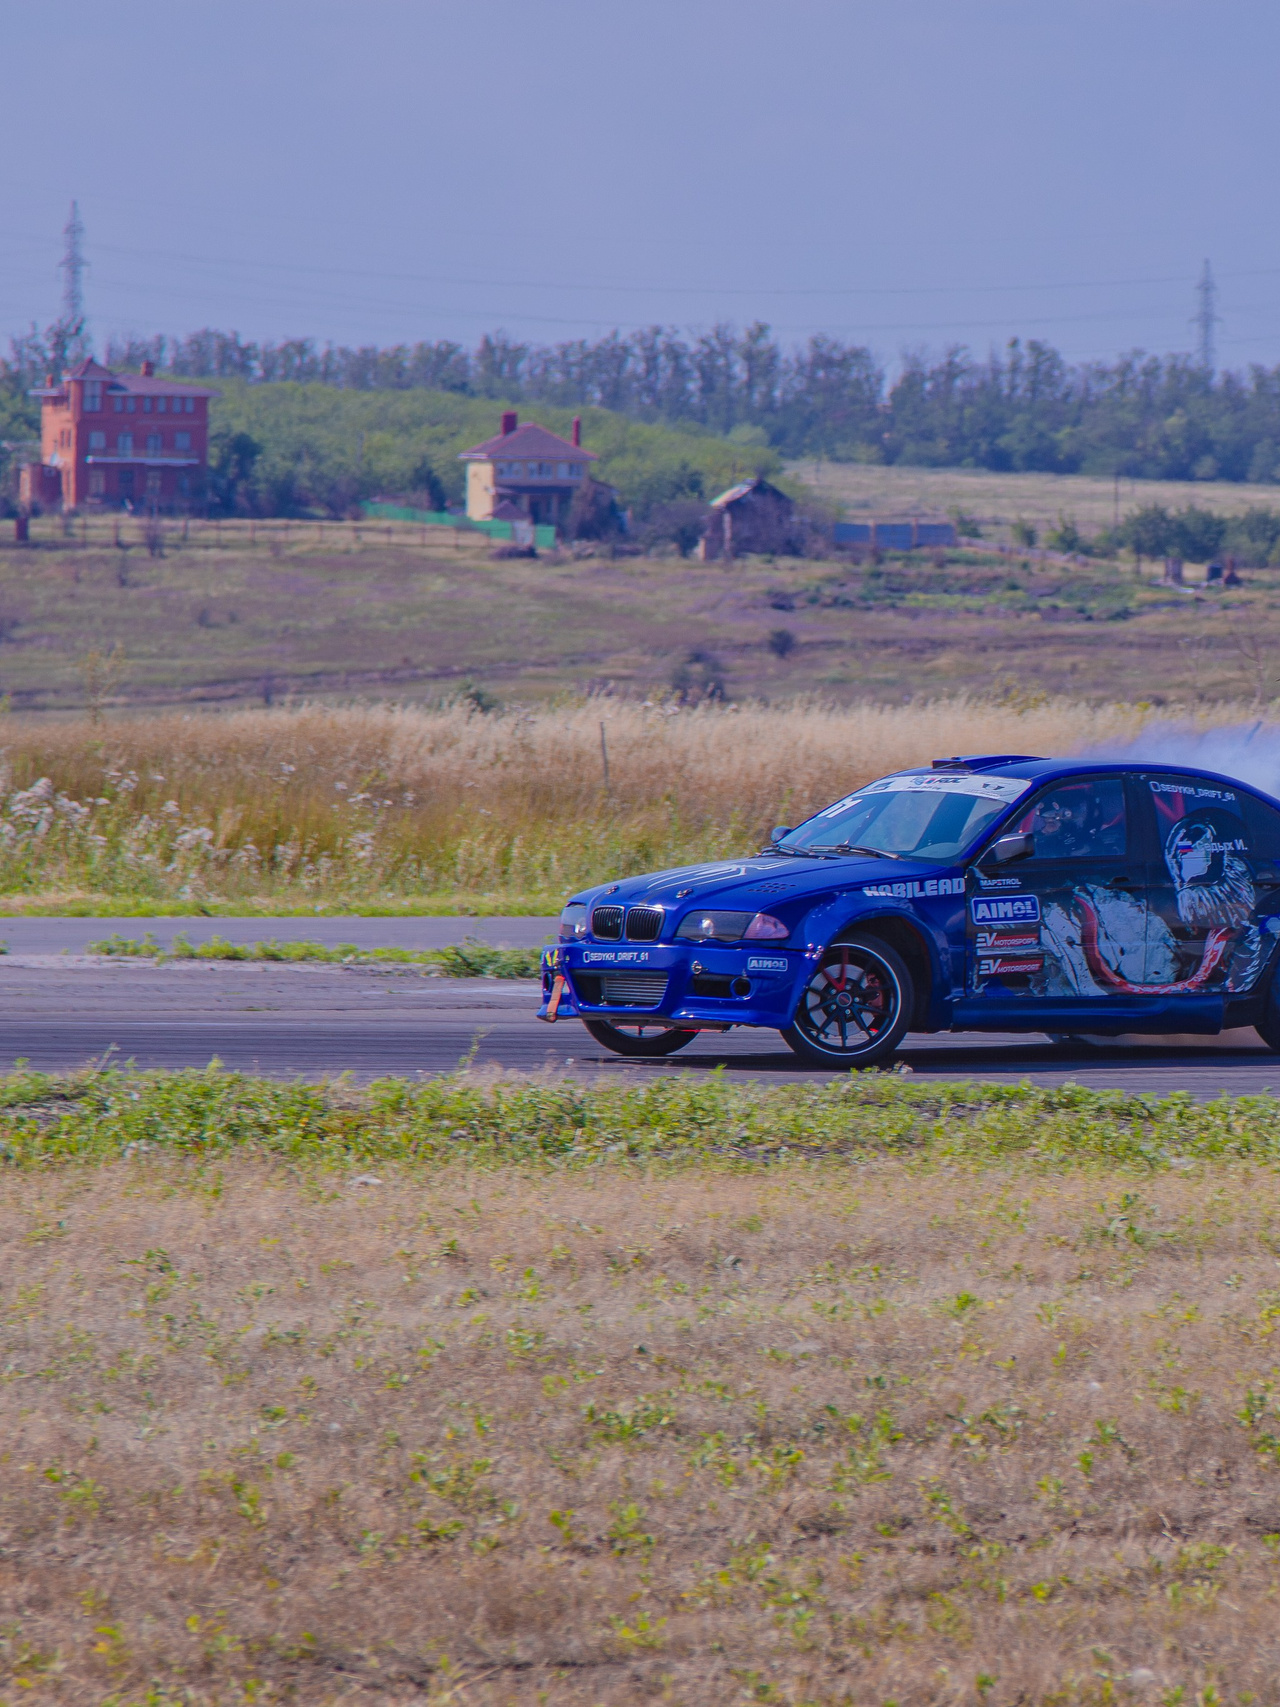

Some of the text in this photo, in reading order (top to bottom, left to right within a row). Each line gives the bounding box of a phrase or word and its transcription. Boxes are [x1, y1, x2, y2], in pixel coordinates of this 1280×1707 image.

[976, 901, 1036, 919] AIMOL
[590, 952, 649, 963] SEDYKH_DRIFT_61
[997, 964, 1040, 974] MOTORSPORT
